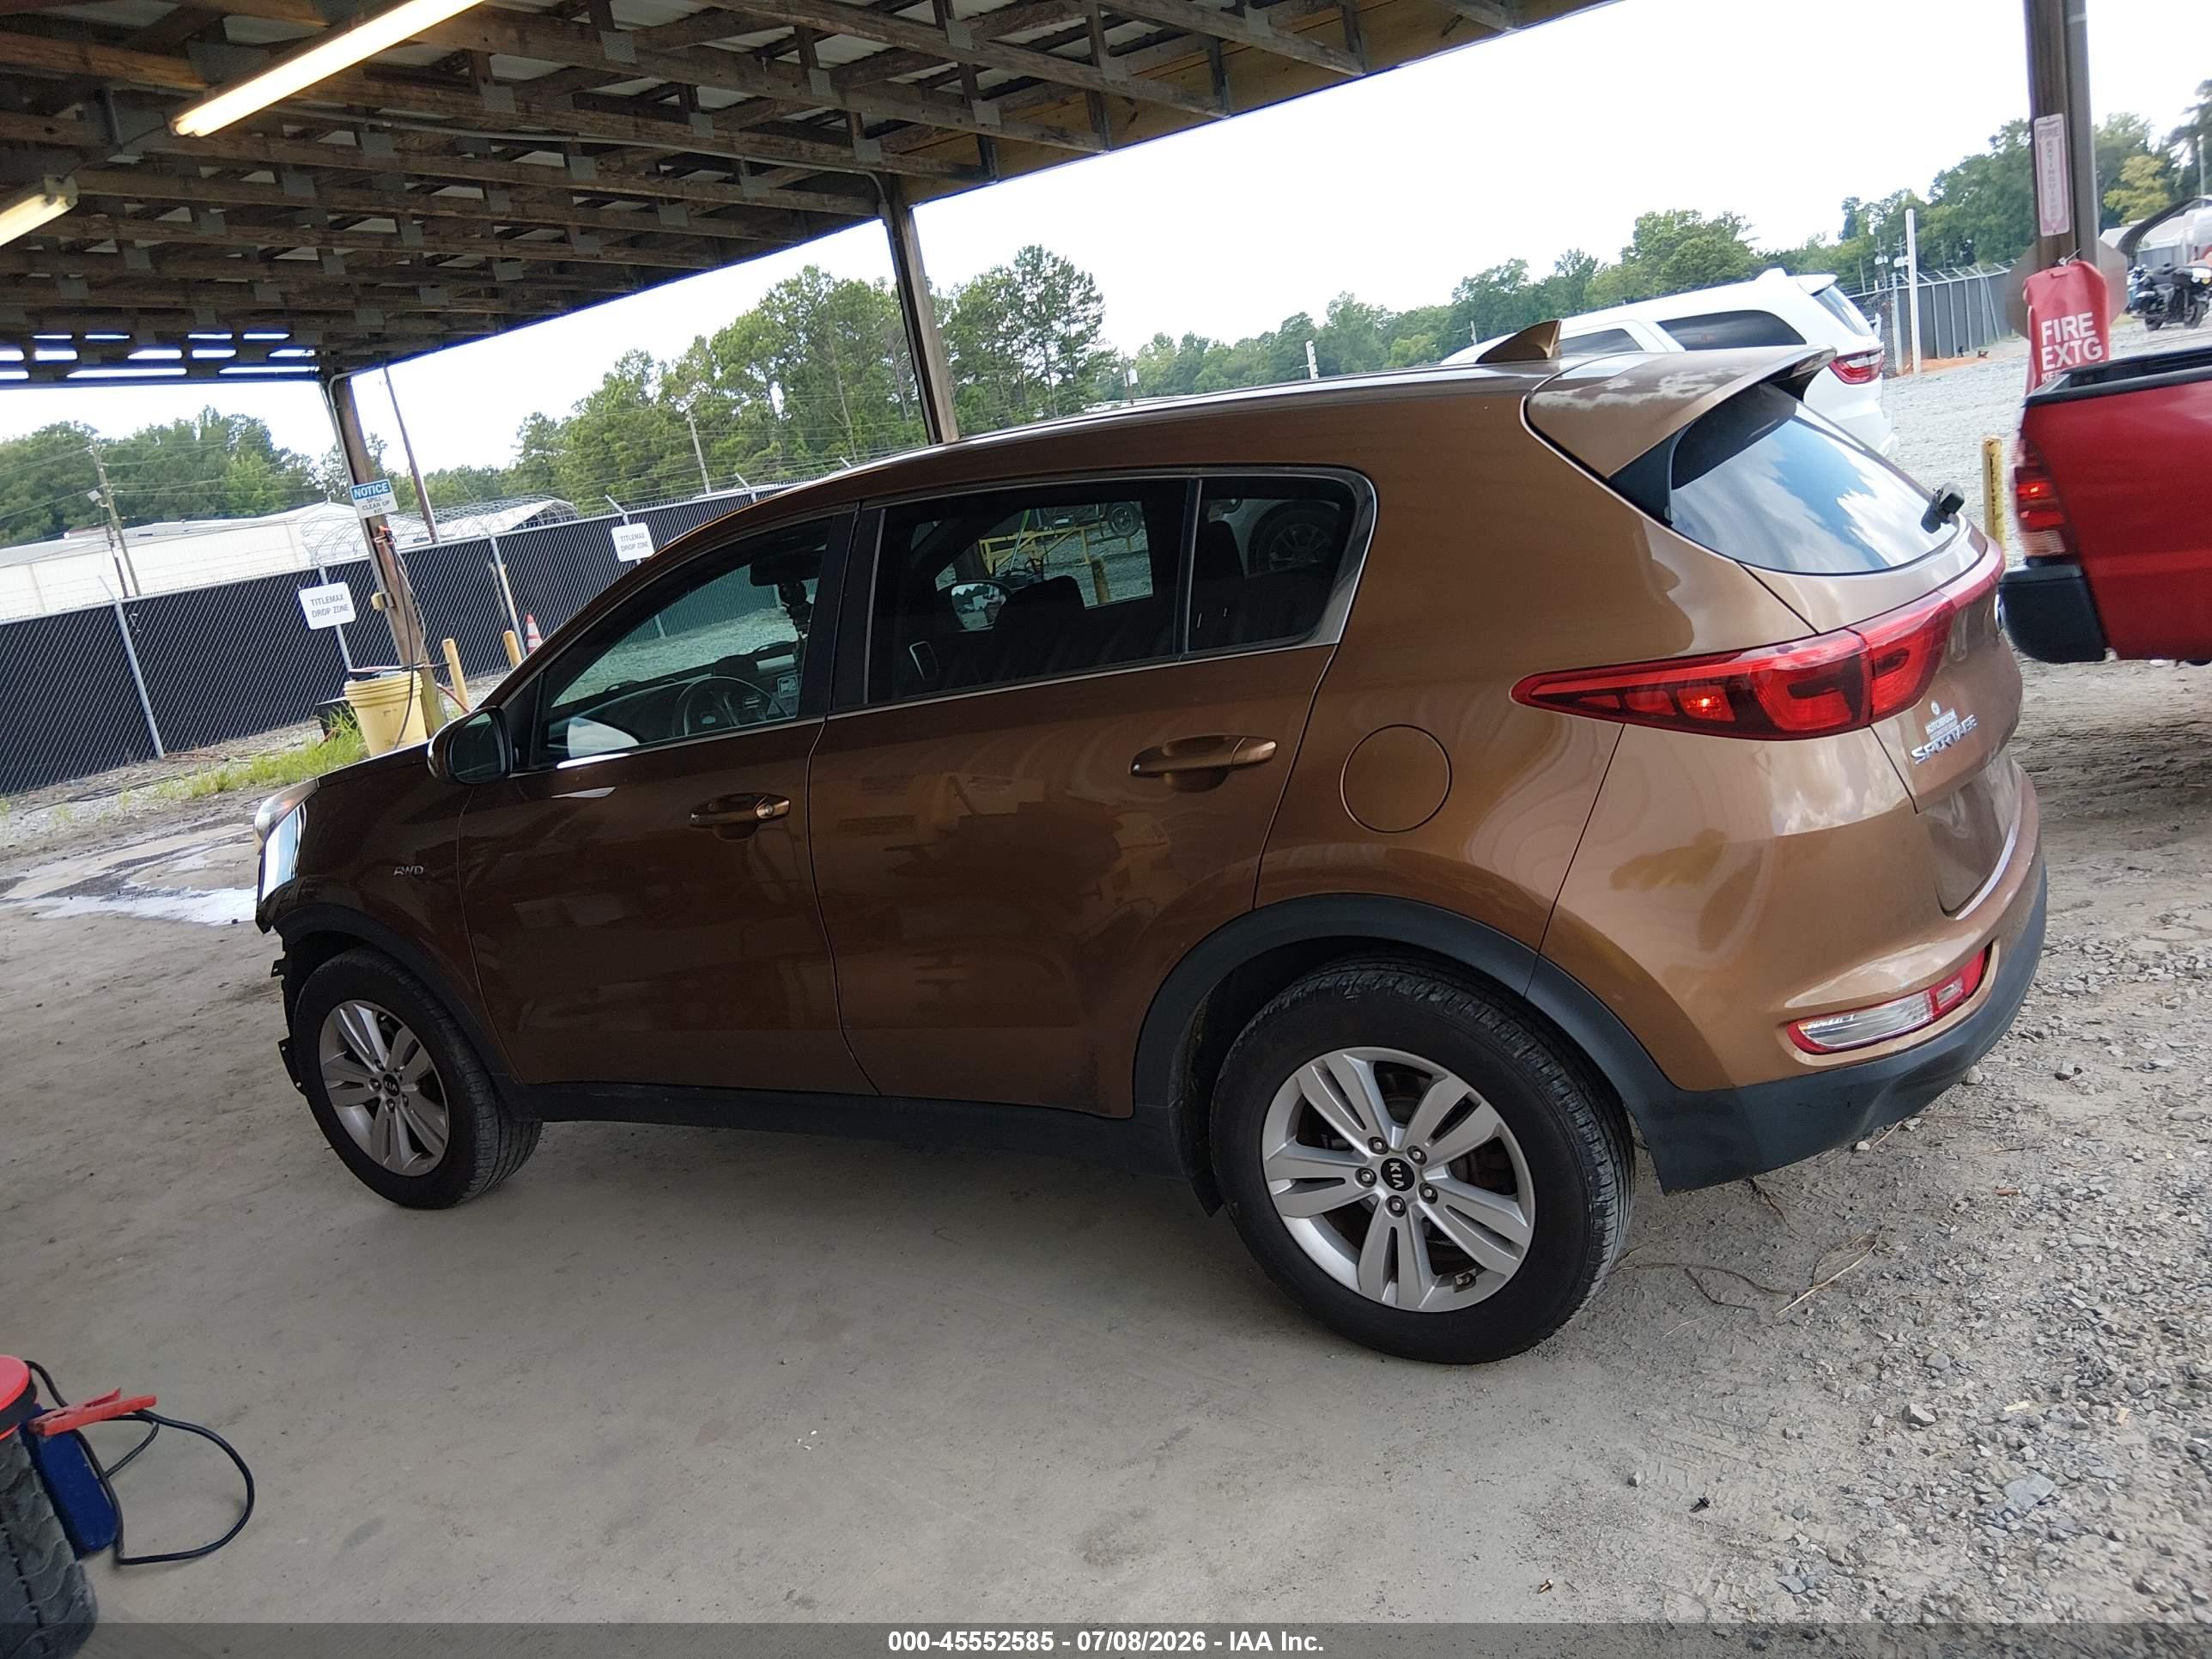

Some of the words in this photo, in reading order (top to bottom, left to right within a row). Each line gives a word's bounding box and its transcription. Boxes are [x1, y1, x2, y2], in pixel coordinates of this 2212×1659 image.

[2041, 312, 2096, 346] FIRE
[2041, 337, 2103, 371] EXTG
[353, 482, 389, 498] NOTICE
[362, 502, 381, 511] CLEAN
[310, 594, 344, 606] TITLEMAX
[312, 607, 331, 618] DROP
[332, 604, 350, 614] ZONE
[393, 865, 424, 876] AWD
[385, 1079, 398, 1092] KIA
[1389, 1162, 1405, 1188] KIA
